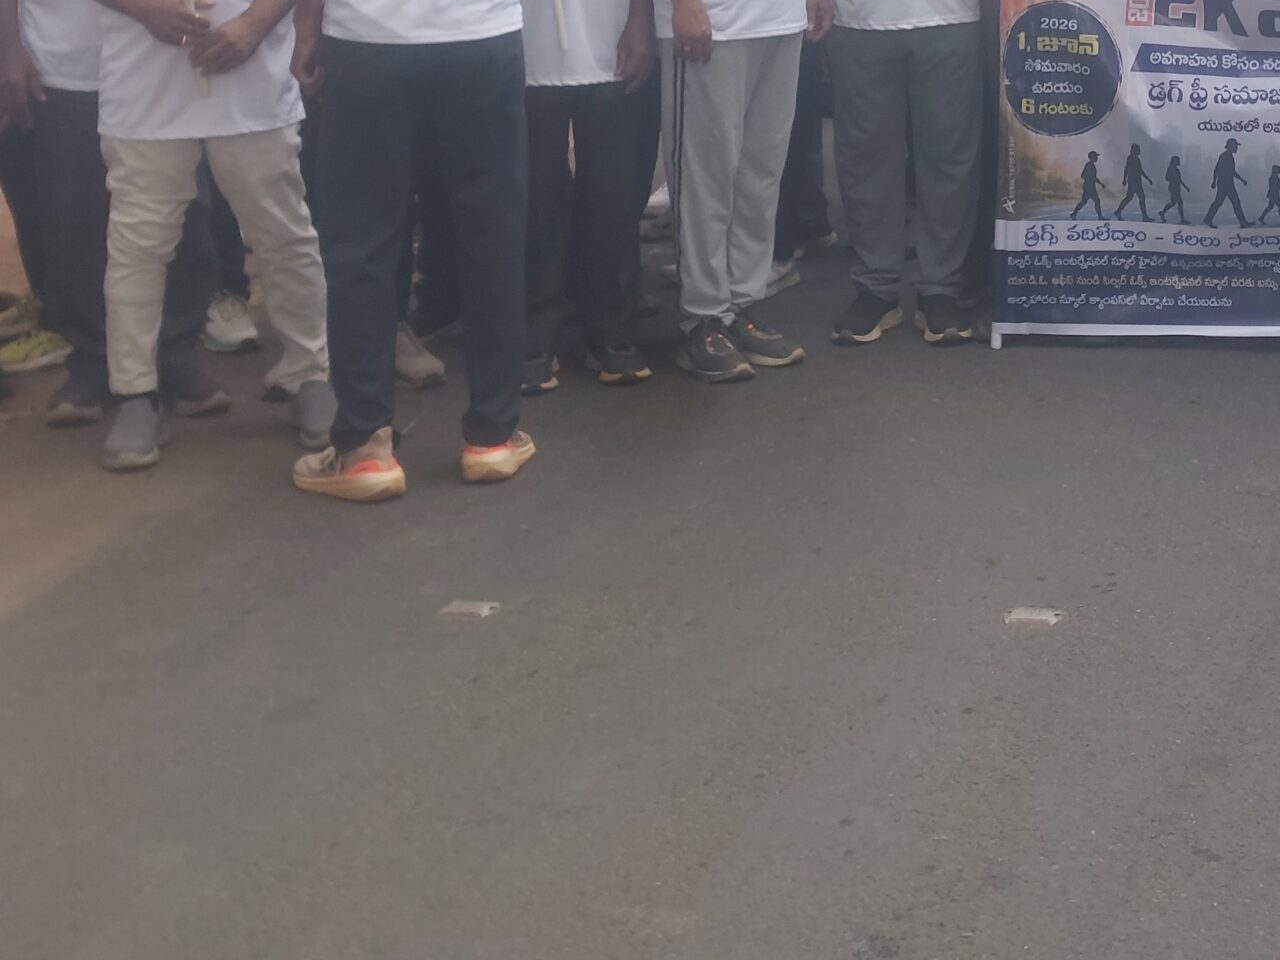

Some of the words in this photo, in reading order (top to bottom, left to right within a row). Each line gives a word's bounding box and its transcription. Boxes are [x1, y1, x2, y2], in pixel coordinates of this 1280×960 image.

[1040, 17, 1078, 31] 2026
[1037, 34, 1099, 55] జూన్
[1025, 58, 1090, 75] సోమవారం
[1150, 50, 1218, 68] అవగాహన
[1222, 53, 1260, 70] కోసం
[1032, 81, 1083, 94] ఉదయం
[1147, 80, 1184, 109] డ్రగ్
[1189, 77, 1208, 111] ఫ్రీ
[1021, 98, 1035, 114] 6
[1038, 102, 1093, 115] గంటలకు
[1198, 118, 1259, 134] యువతలో
[1024, 224, 1059, 248] డ్రగ్స్
[1066, 224, 1147, 249] వదిలేద్దాం
[1172, 231, 1221, 248] కలలు
[1060, 294, 1087, 309] స్కూల్
[1140, 295, 1174, 309] ఏర్పాటు
